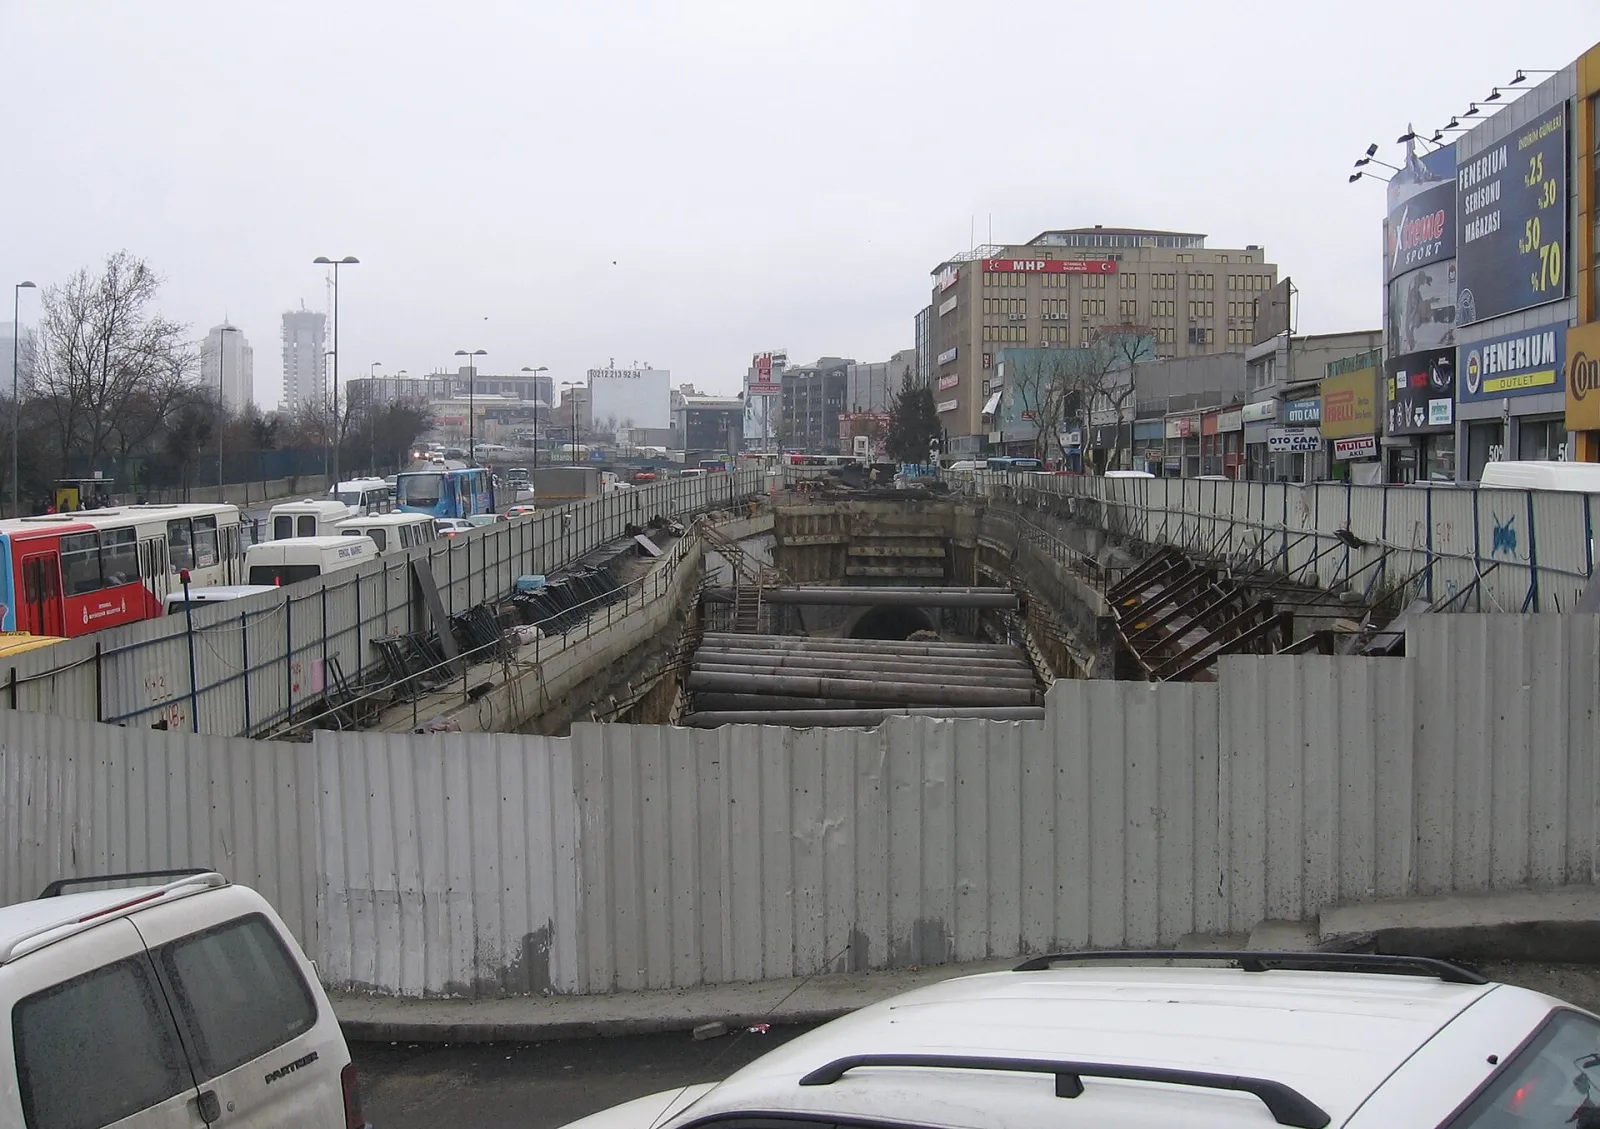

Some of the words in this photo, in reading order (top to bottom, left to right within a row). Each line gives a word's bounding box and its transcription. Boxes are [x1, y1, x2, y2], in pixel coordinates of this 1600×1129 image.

[1459, 145, 1507, 192] FENERIUM
[1465, 179, 1501, 215] SERİSONU
[1465, 210, 1501, 244] MAĞAZASI
[1013, 261, 1046, 271] MHP
[1405, 240, 1442, 265] SPORT
[1531, 241, 1561, 292] %70
[1483, 331, 1556, 375] FENERIUM
[593, 370, 609, 378] 0212
[610, 370, 622, 378] 213
[623, 371, 631, 379] 92
[1500, 375, 1534, 389] OUTLET
[1289, 409, 1303, 421] OTO
[1304, 408, 1320, 420] CAM
[1336, 438, 1374, 452] MUTLU
[265, 1051, 319, 1084] PARTNER
